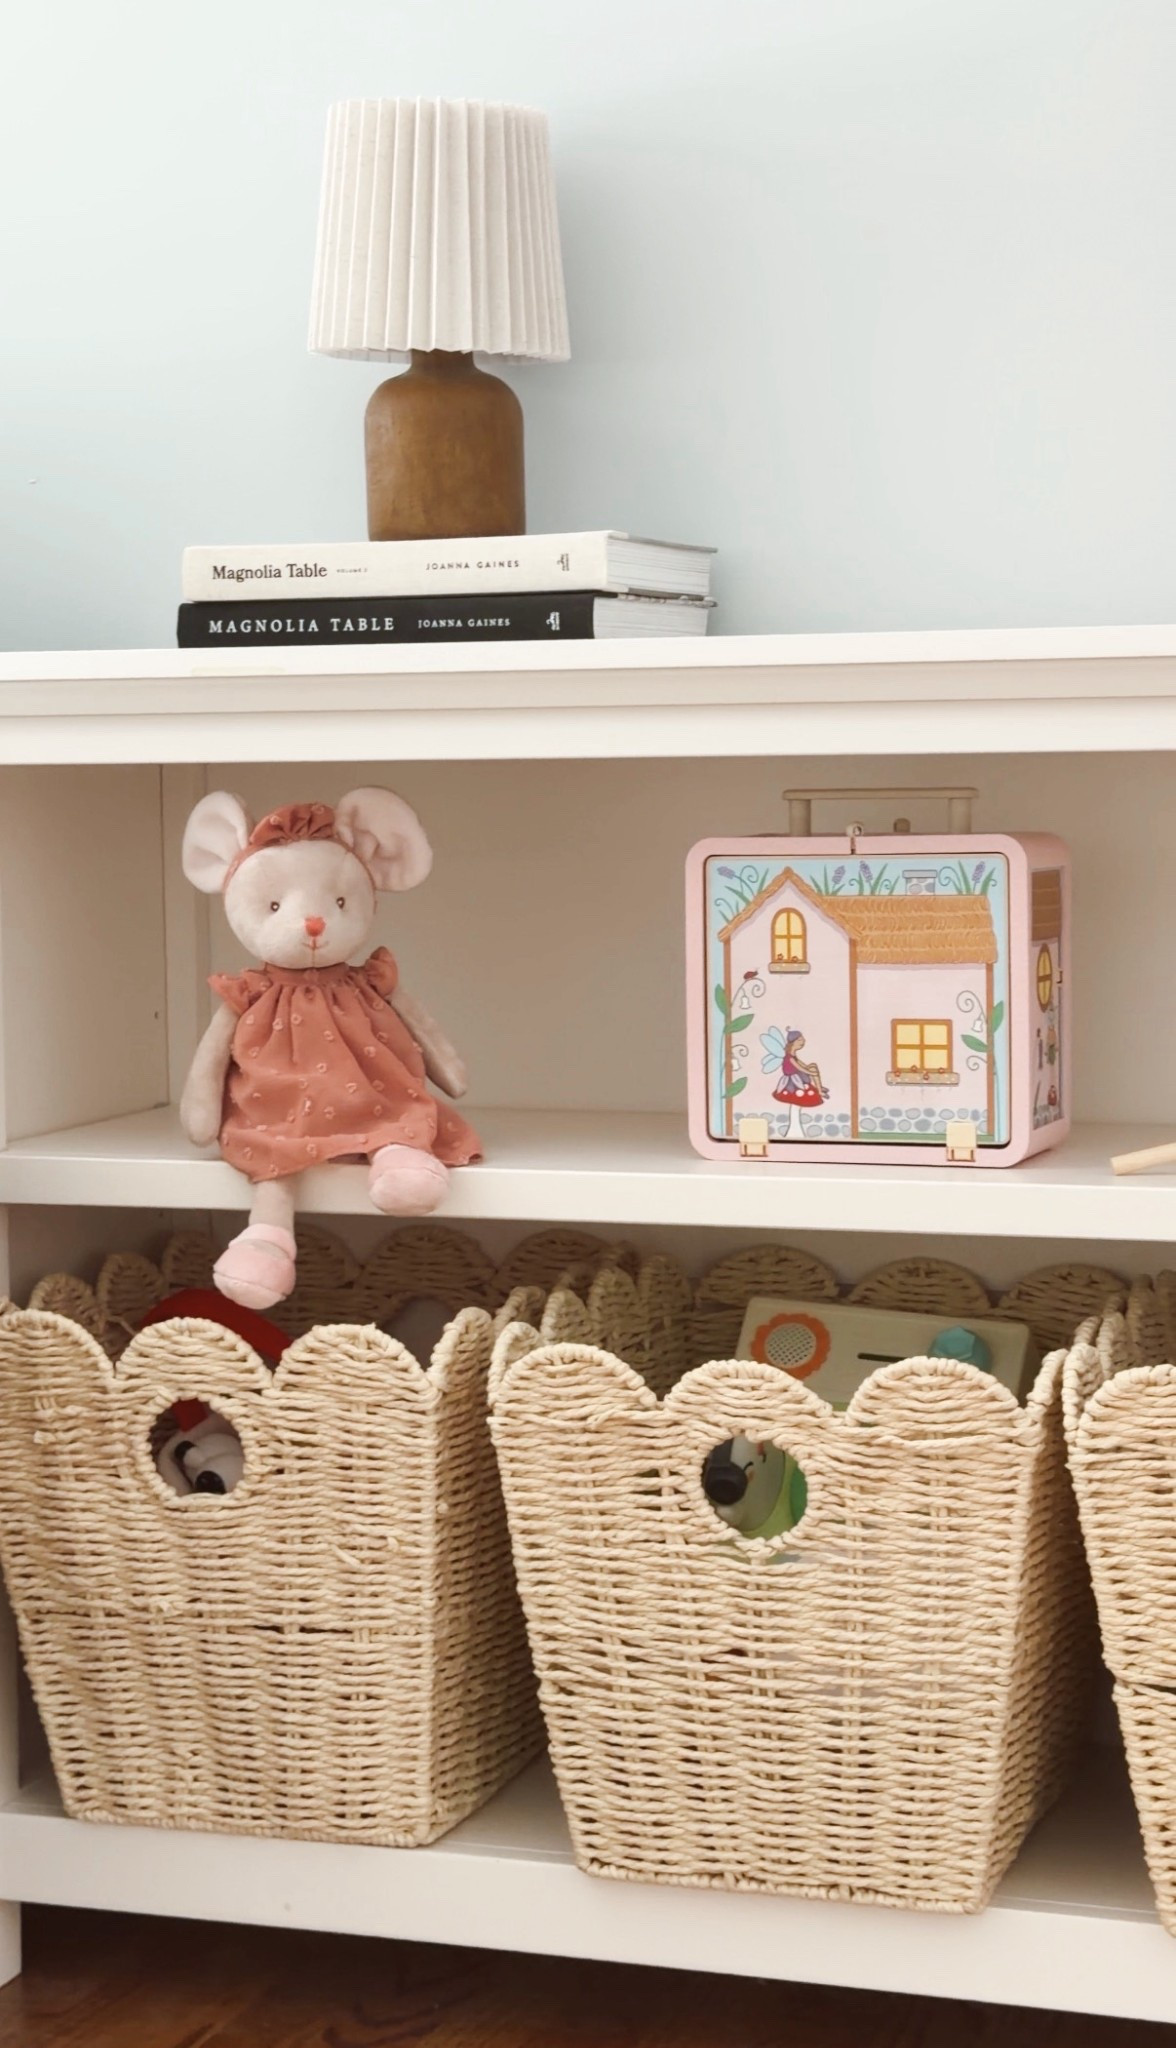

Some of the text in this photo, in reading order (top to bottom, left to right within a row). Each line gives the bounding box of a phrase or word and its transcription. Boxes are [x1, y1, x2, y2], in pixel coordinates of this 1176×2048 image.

[426, 560, 520, 571] JOANNA GAINES
[212, 563, 328, 583] Magnolia Table
[208, 617, 394, 634] MAGNOLIA TABLE
[418, 618, 511, 629] JOANNA GAINES
